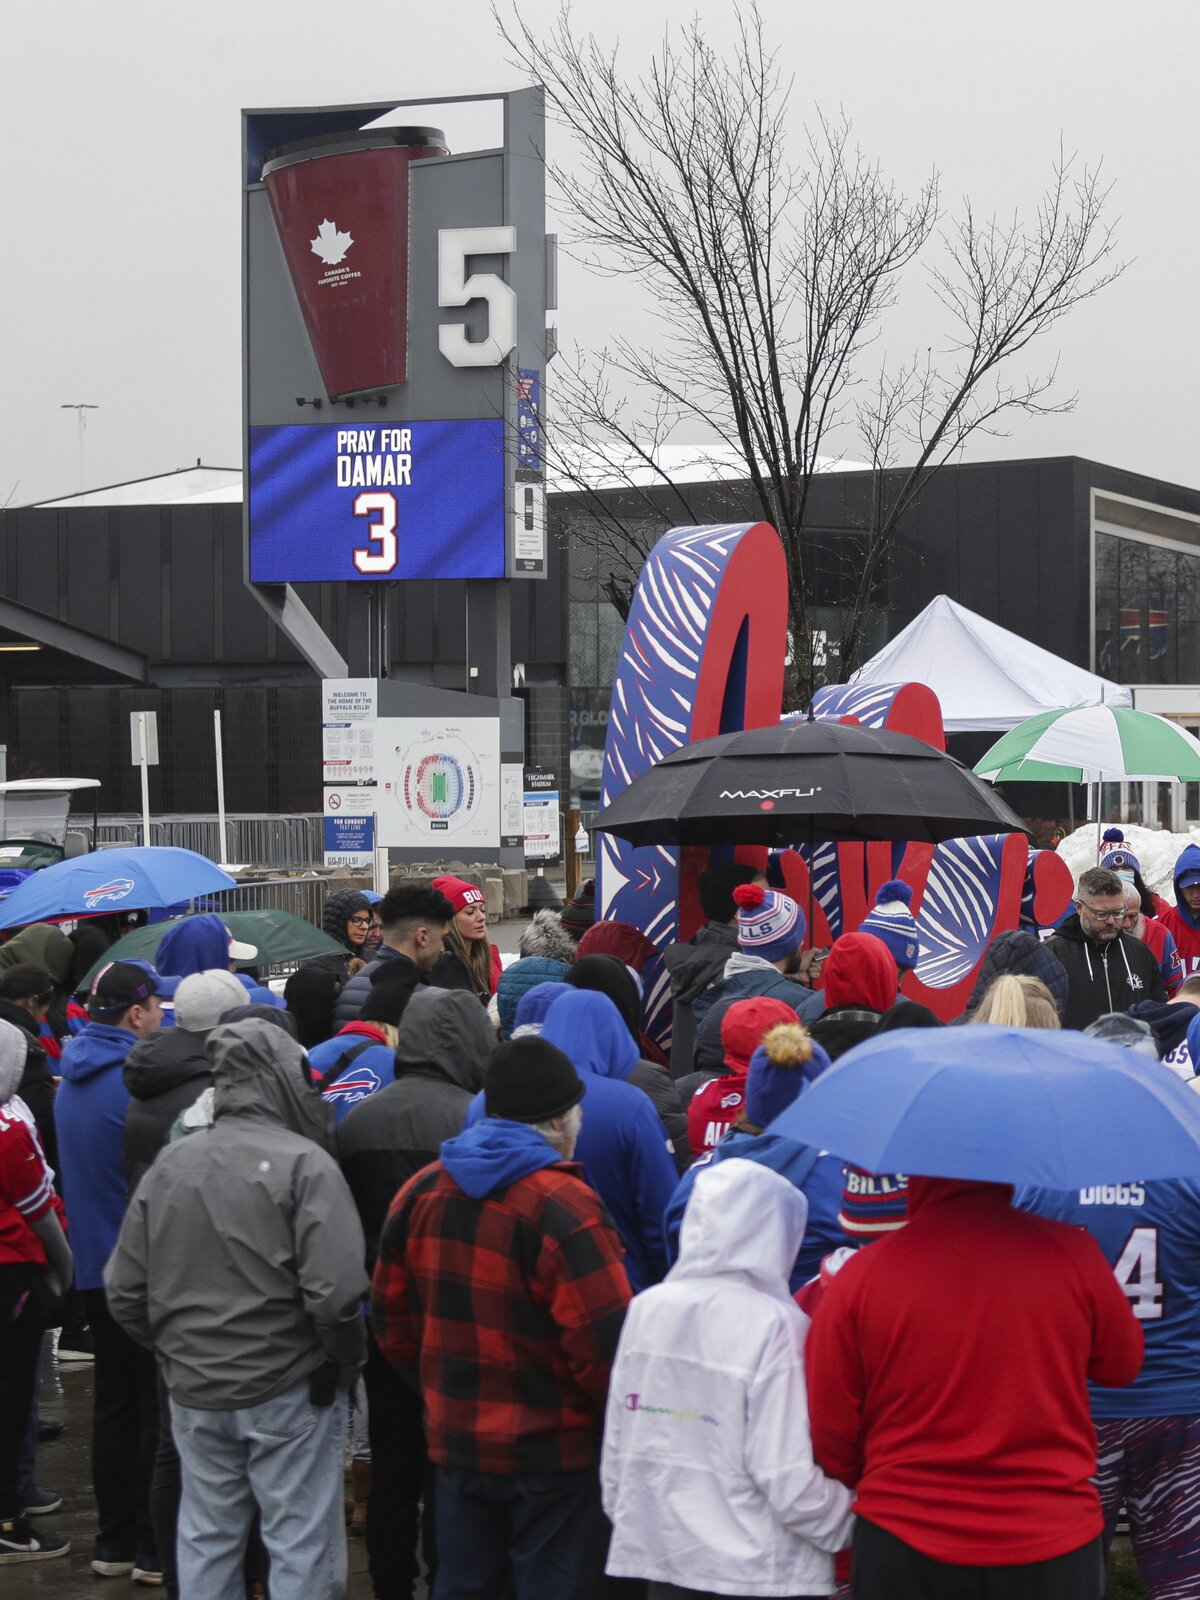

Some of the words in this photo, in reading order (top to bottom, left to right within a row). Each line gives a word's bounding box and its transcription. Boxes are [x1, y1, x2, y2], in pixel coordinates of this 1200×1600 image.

[324, 267, 350, 277] CANADA'S
[341, 272, 361, 280] COFFEE
[438, 226, 517, 367] 5
[337, 430, 376, 454] PRAY
[381, 429, 411, 452] FOR
[337, 454, 412, 487] DAMAR
[353, 491, 398, 574] 3
[528, 774, 555, 782] HIGHMARK
[719, 787, 815, 799] MAXFLI
[462, 889, 484, 904] BU
